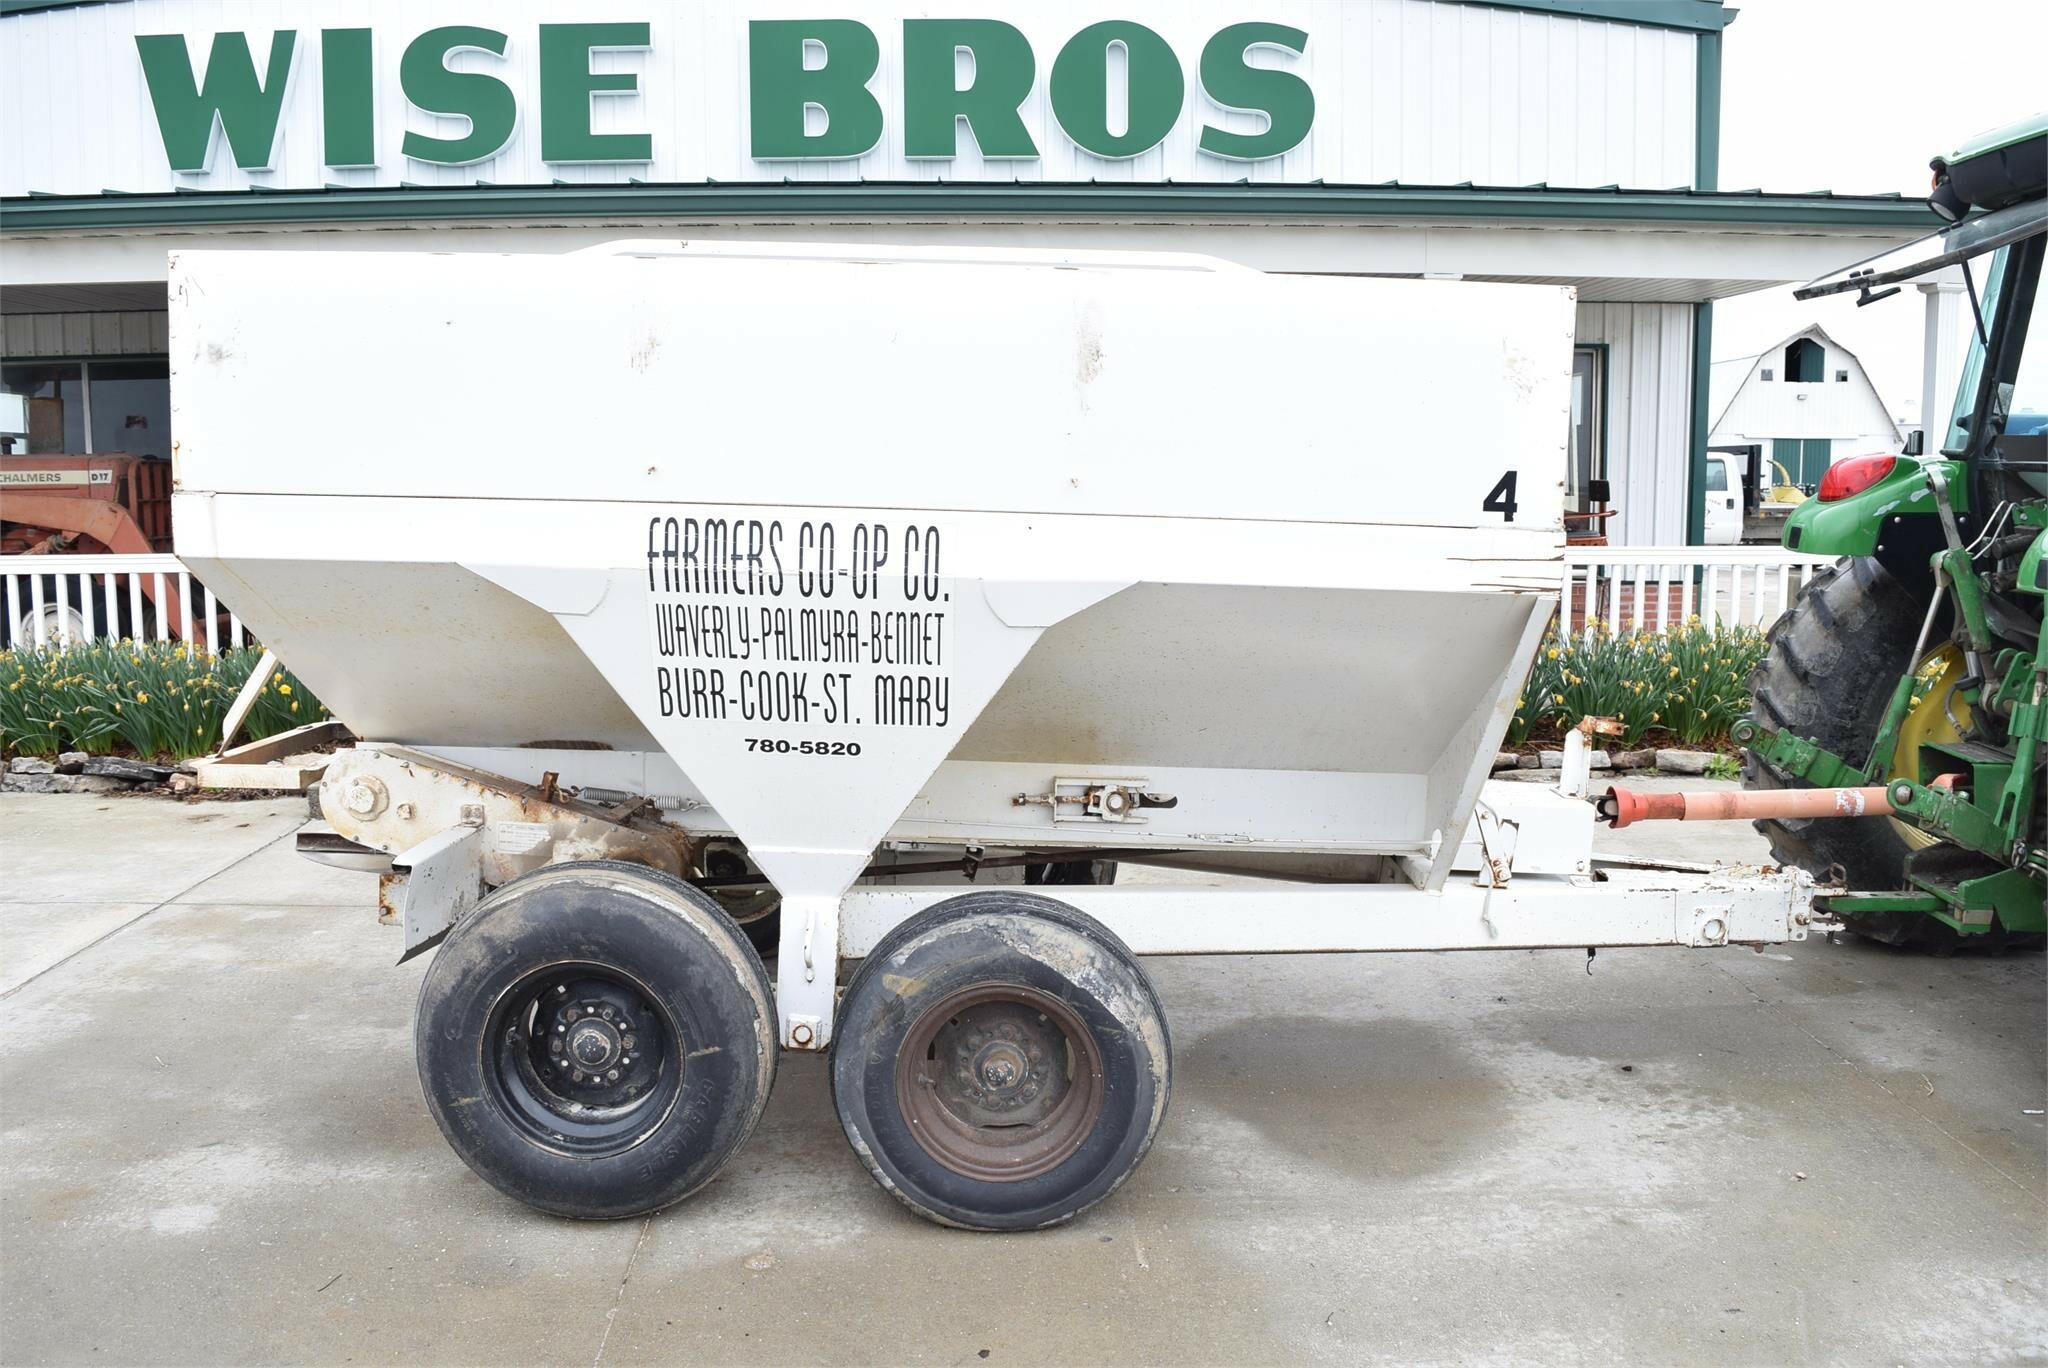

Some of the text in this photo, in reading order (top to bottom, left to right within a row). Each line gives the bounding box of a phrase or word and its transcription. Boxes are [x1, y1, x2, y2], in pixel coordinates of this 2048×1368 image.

[135, 19, 1315, 172] WISE BROS
[1483, 471, 1518, 522] 4
[647, 517, 949, 602] FARMERS CO-OP CO.
[655, 603, 945, 666] WAVERLY-PALMYRA-BENNET
[657, 666, 949, 727] BURR-COOK-ST. MARY
[744, 738, 862, 757] 780-5820
